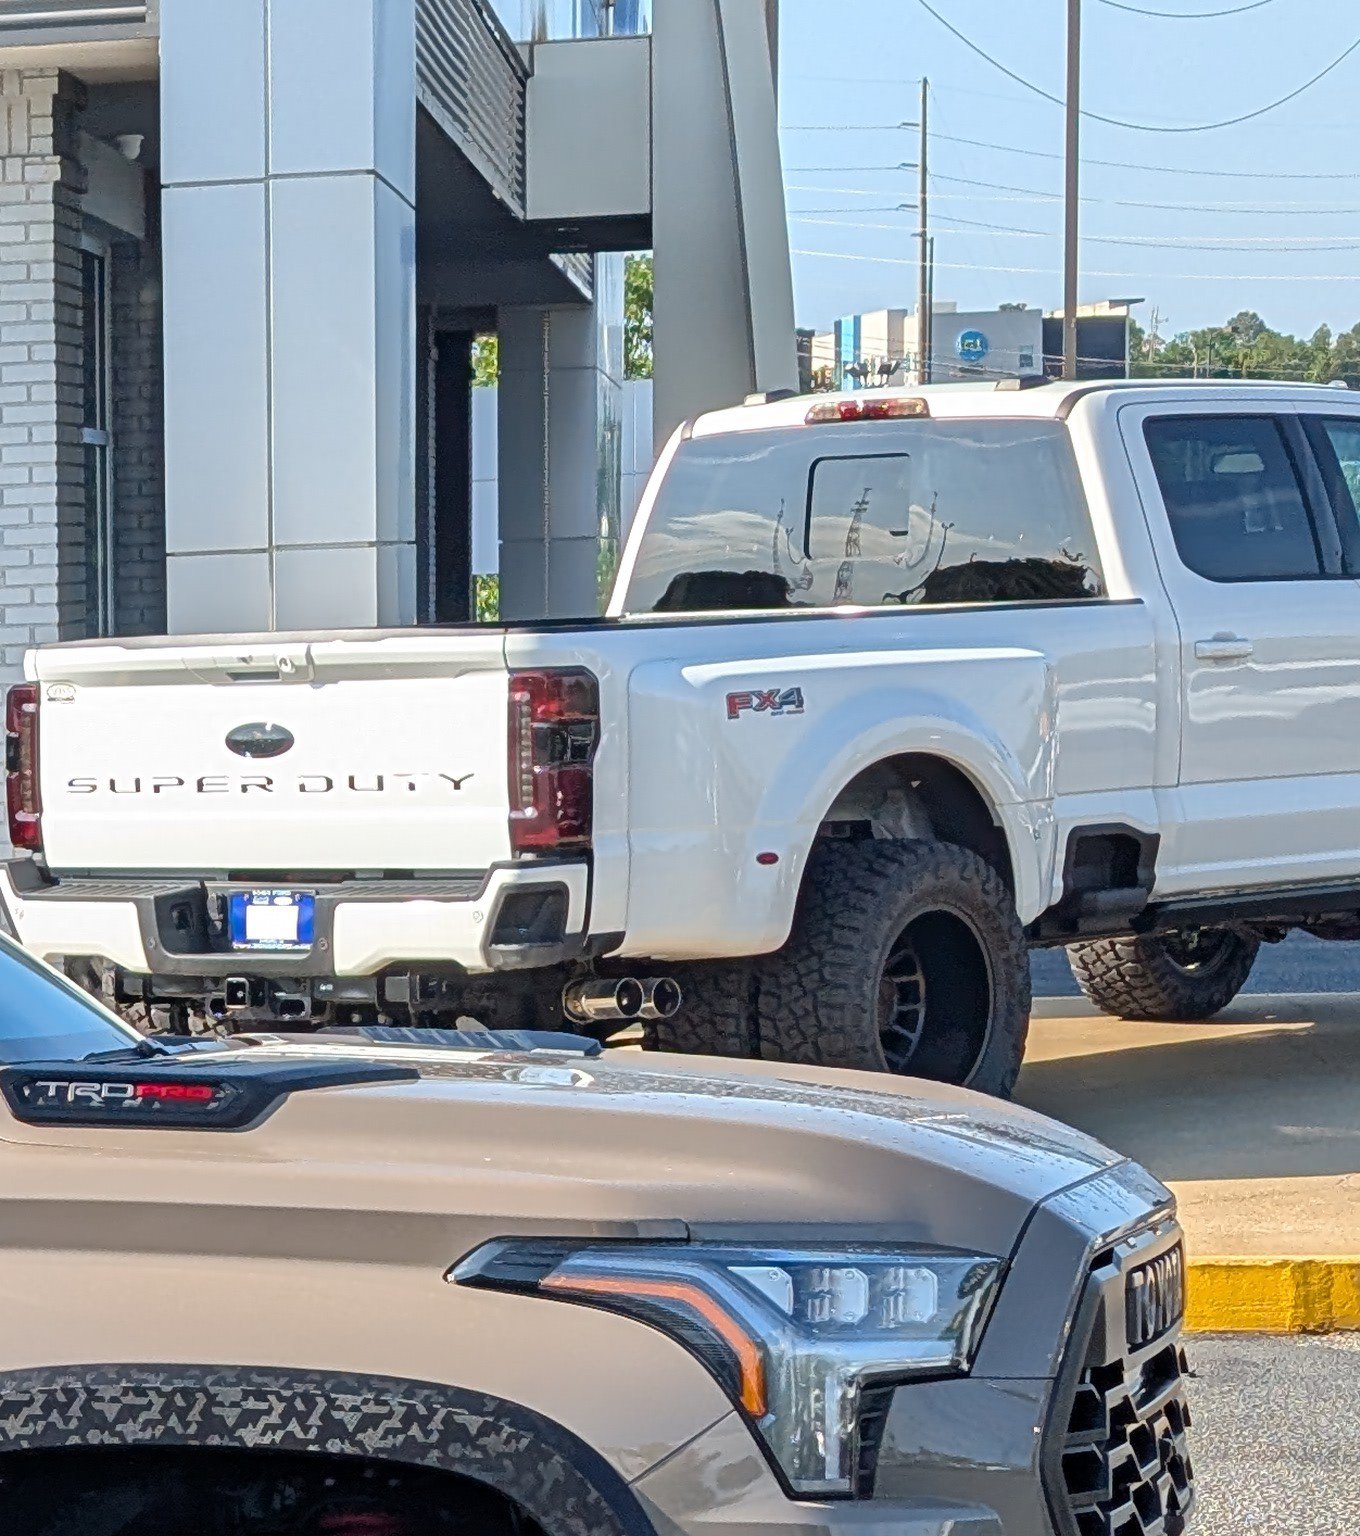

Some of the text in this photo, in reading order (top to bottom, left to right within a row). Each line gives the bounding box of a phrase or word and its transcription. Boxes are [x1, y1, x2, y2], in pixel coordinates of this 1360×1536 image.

[726, 687, 804, 719] FX4
[67, 773, 475, 794] SUPER DUTY
[35, 1081, 213, 1102] TRD PRO
